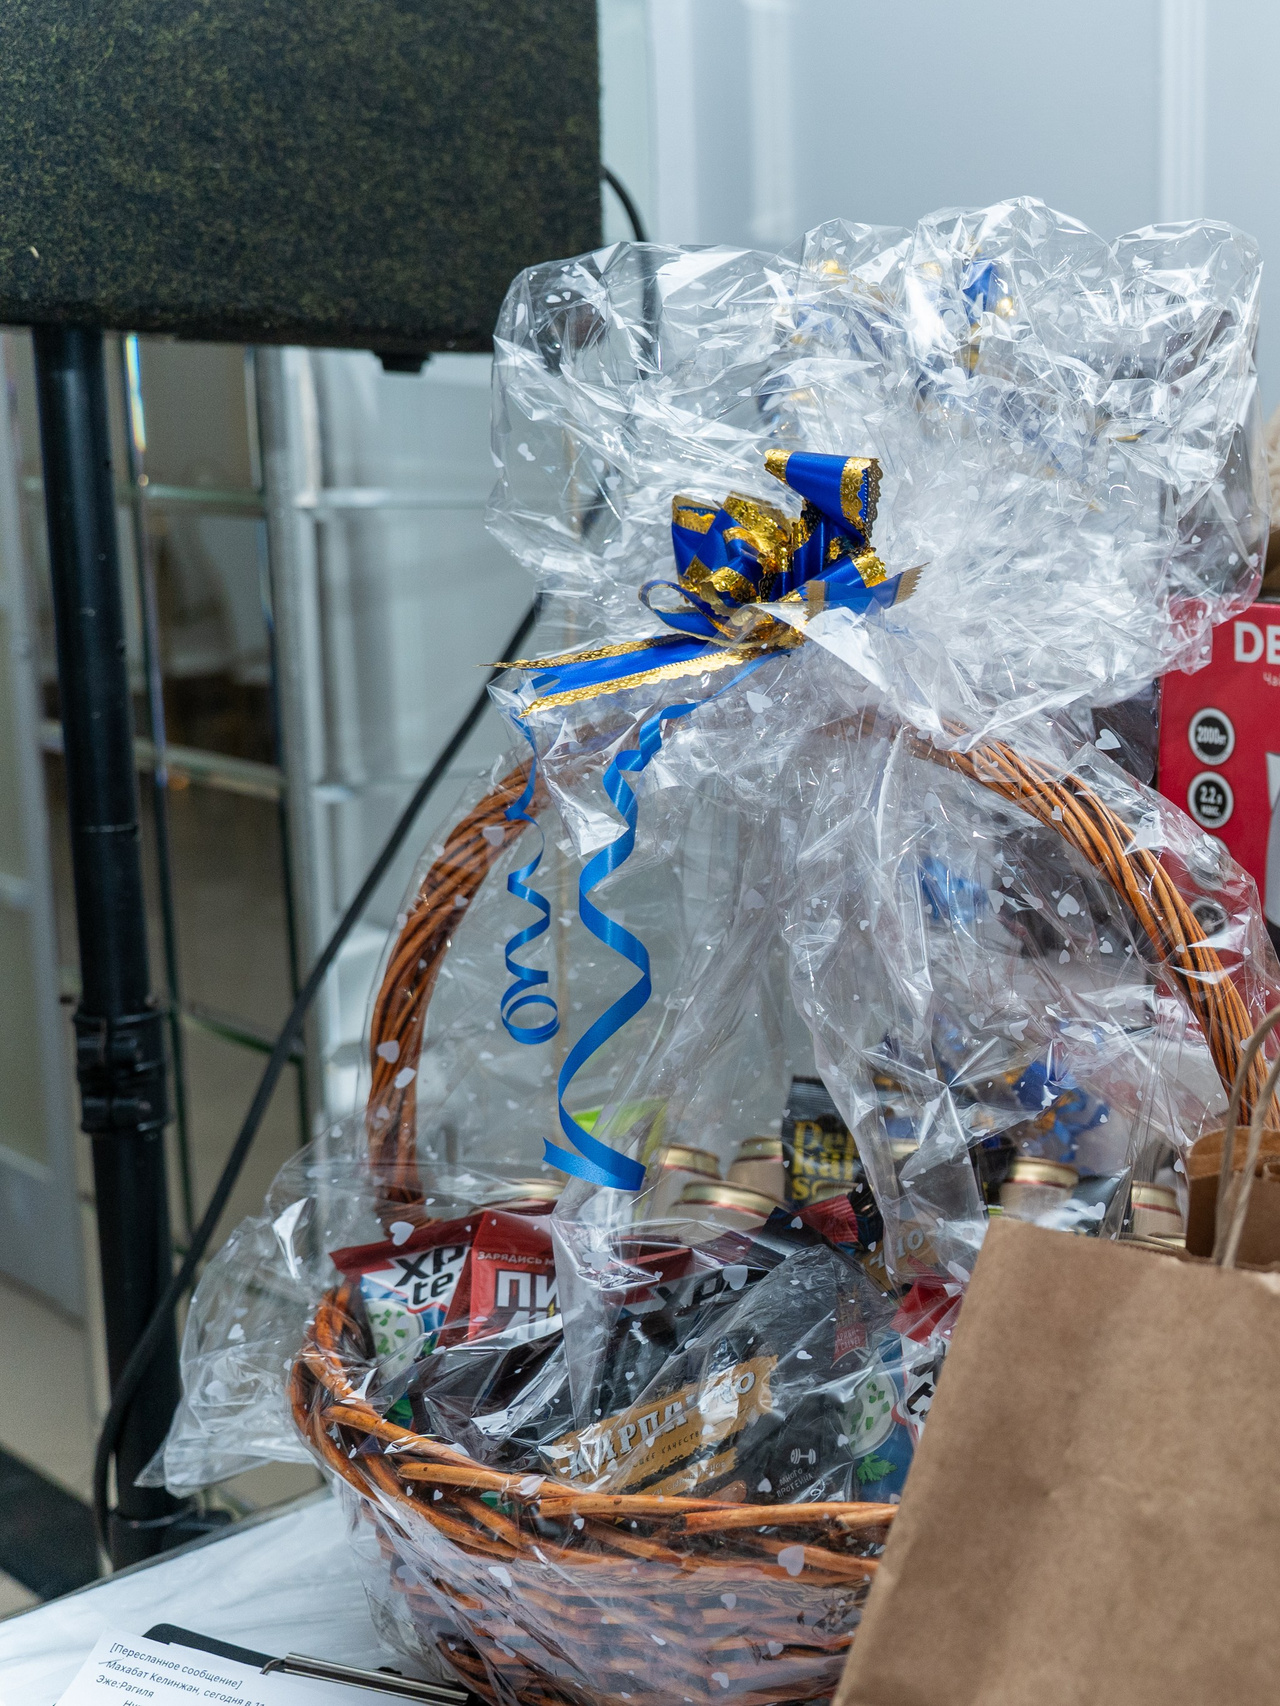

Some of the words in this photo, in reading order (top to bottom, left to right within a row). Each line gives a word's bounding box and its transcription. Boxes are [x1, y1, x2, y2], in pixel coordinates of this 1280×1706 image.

[477, 1251, 543, 1266] ЗАРЯДИСЬ
[568, 1371, 756, 1480] КАРПАО
[661, 1430, 701, 1454] КАЧЕСТВ
[106, 1660, 150, 1679] Махабат
[149, 1673, 201, 1696] Келинжан,
[110, 1642, 180, 1671] [Пересланное
[181, 1664, 243, 1690] сообщение]
